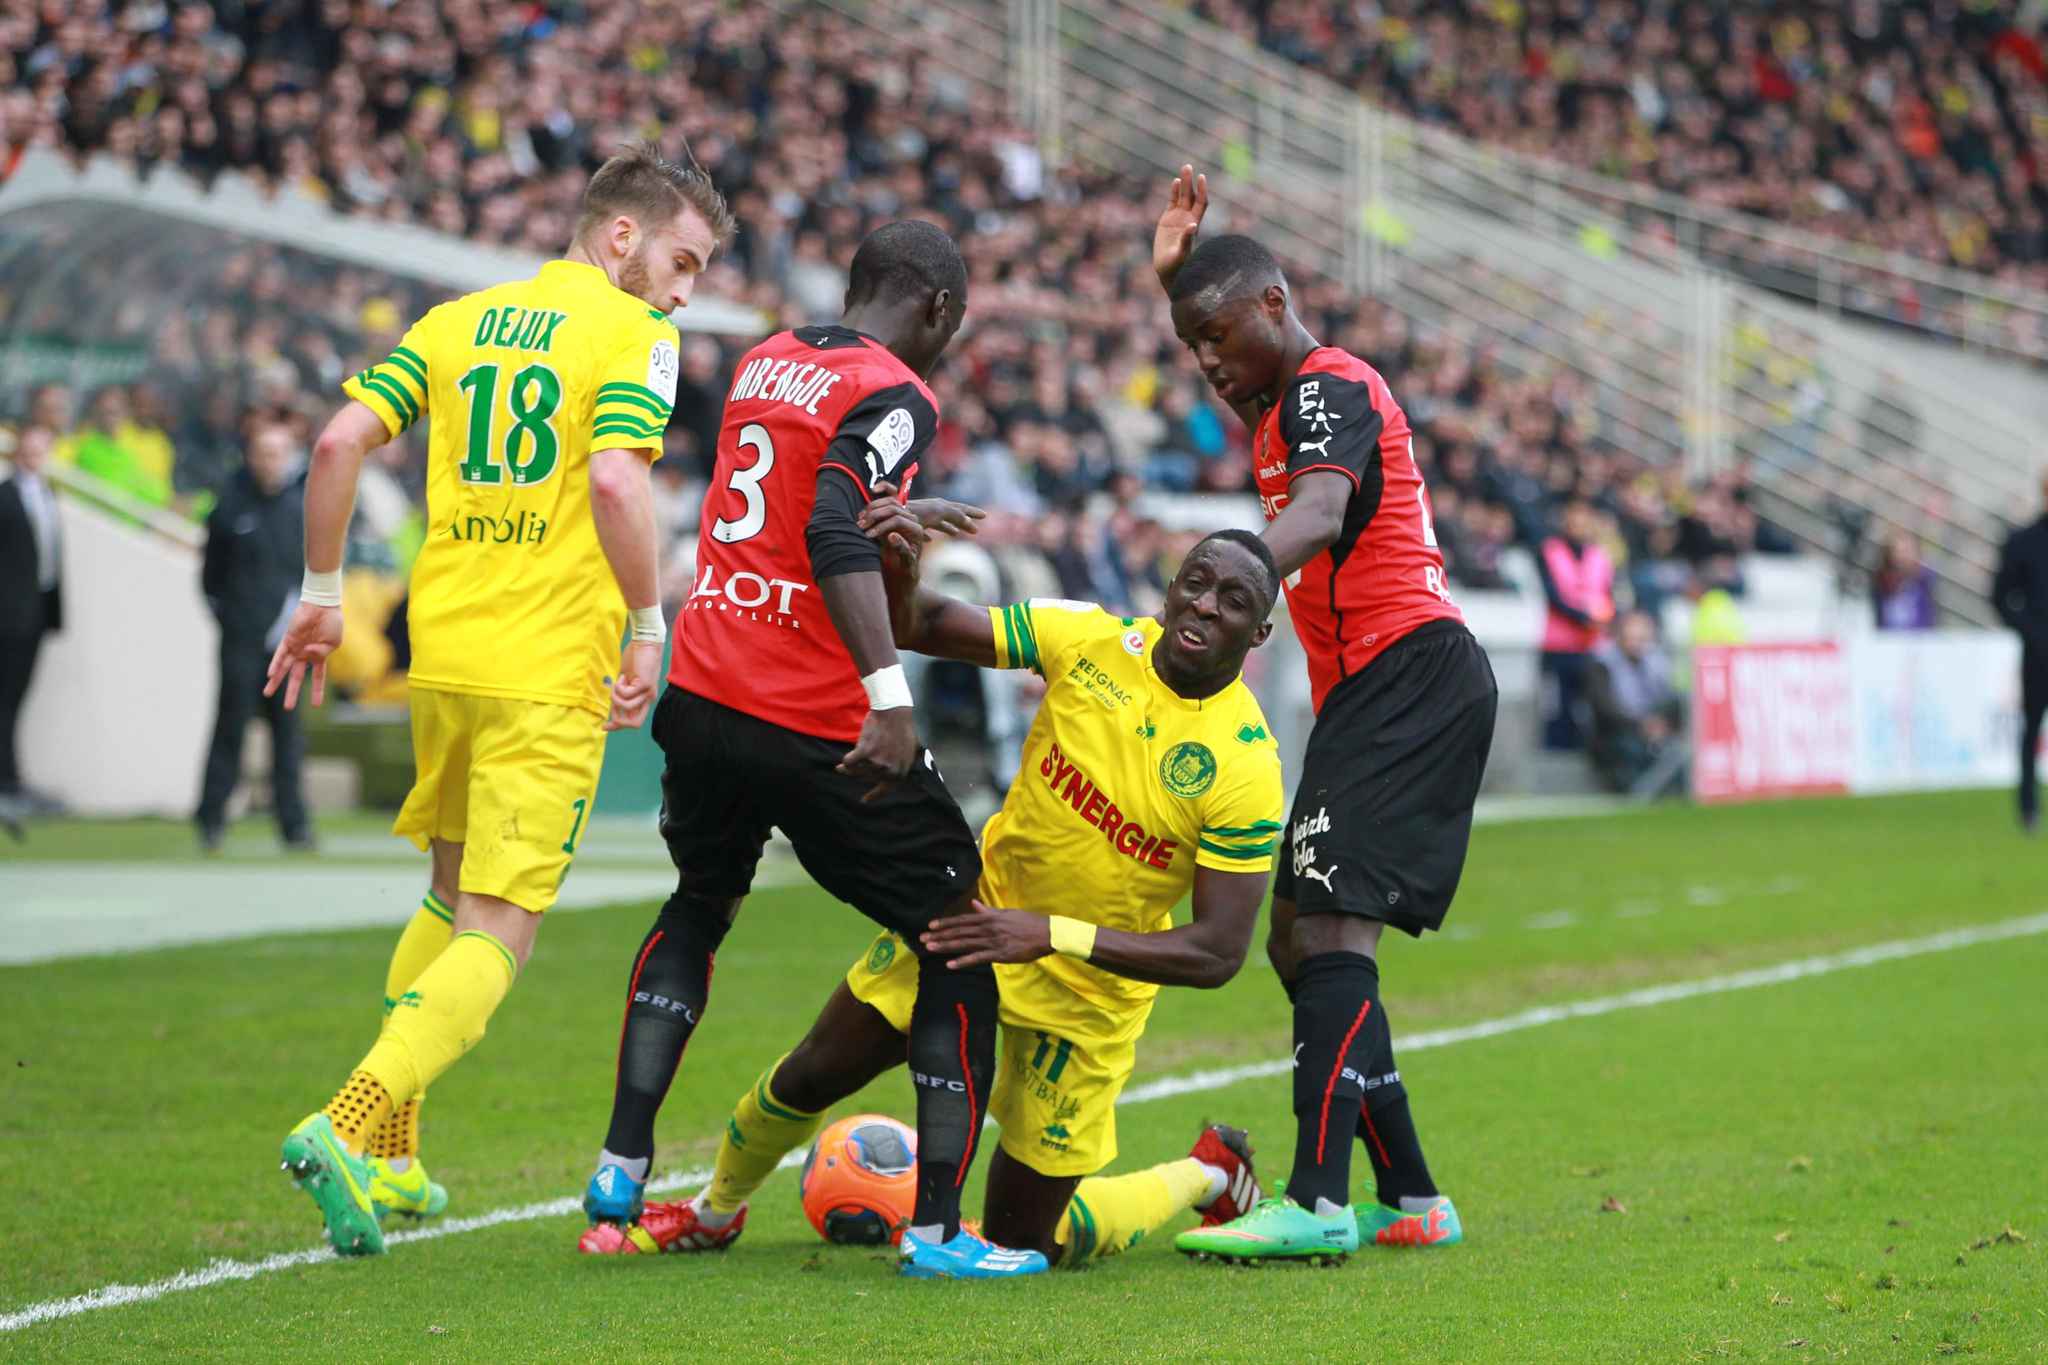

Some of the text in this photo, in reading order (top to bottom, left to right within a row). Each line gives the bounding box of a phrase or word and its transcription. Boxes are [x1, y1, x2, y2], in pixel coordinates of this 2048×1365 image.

[730, 357, 841, 416] MBENGUE
[1298, 380, 1320, 416] ELA
[459, 364, 560, 484] 18
[711, 424, 775, 544] 3
[689, 563, 809, 615] LOT
[1076, 653, 1133, 706] REIGNAC
[1040, 743, 1180, 871] SYNERGIE
[1031, 1031, 1074, 1085] 11
[1375, 1207, 1451, 1248] NIKE
